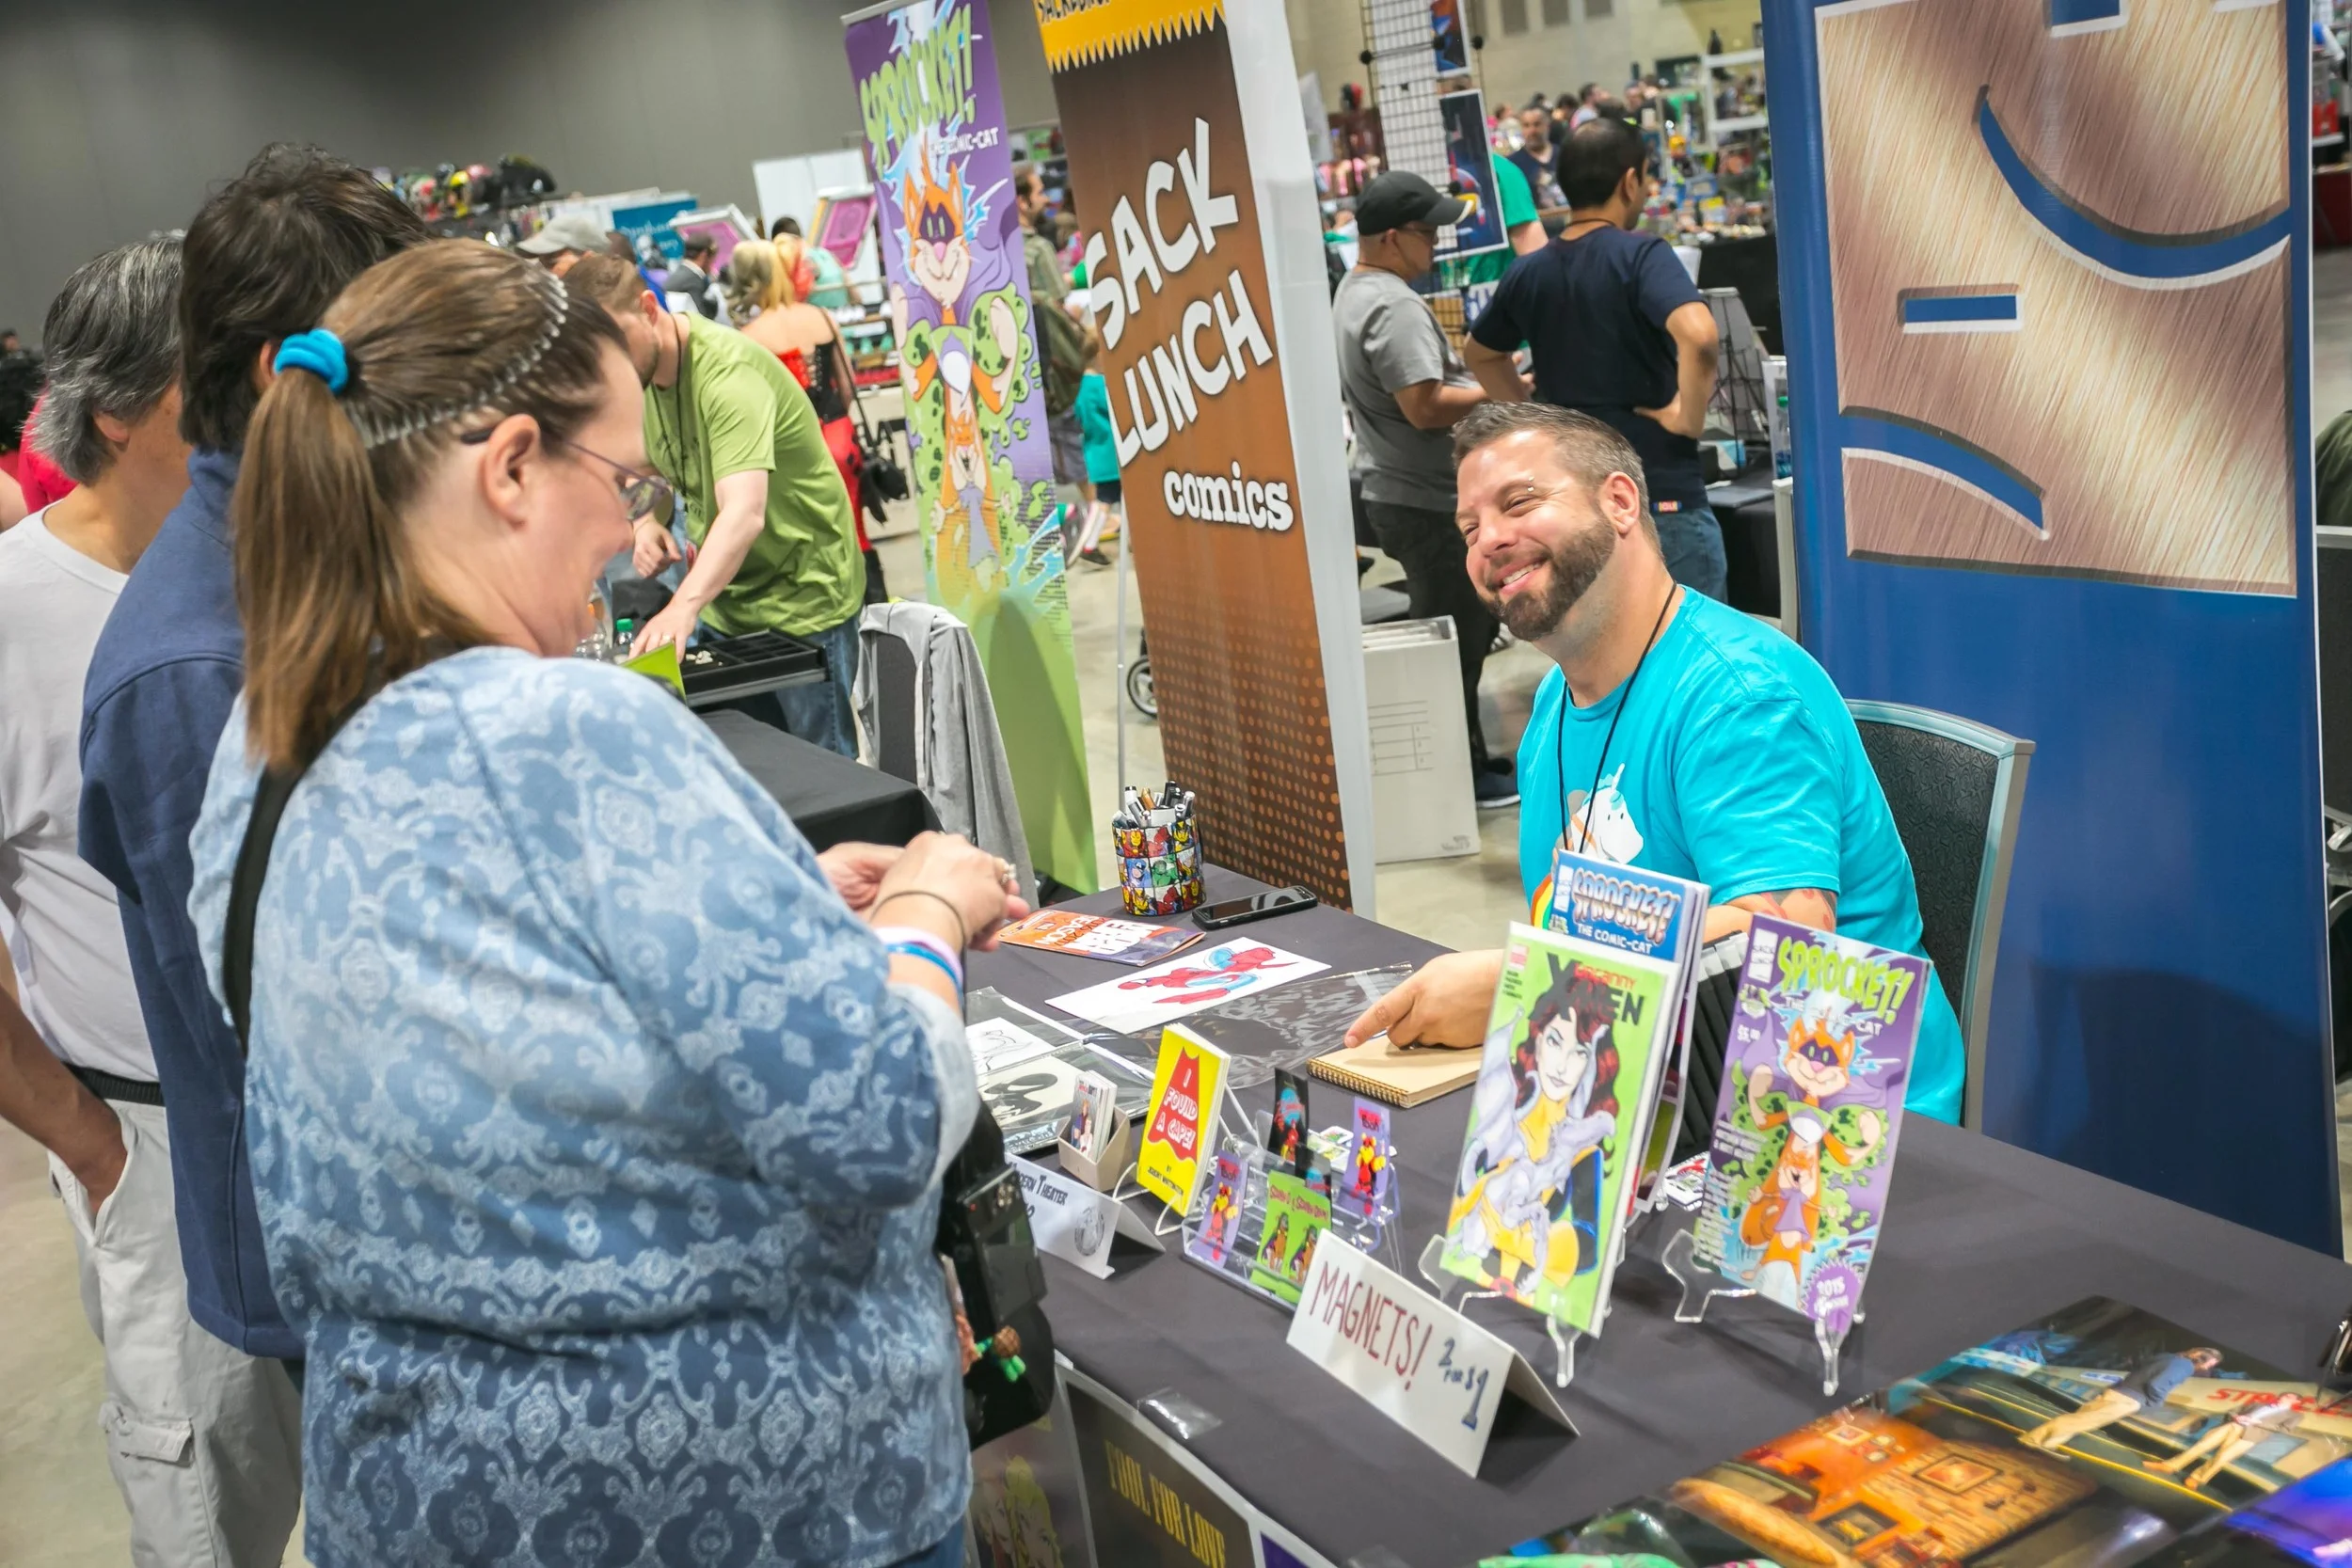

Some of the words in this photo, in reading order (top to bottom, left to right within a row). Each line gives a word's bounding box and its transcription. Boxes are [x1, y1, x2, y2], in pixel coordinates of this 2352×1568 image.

[860, 3, 977, 182] SPROCKET!
[1086, 117, 1240, 352] SACK
[1104, 269, 1274, 468] LUNCH
[1164, 460, 1294, 531] comics
[1571, 867, 1681, 945] SPROCKET!
[1576, 923, 1593, 938] THE
[1594, 928, 1654, 955] COMIC-CAT
[1777, 936, 1915, 1025] SPROCKET!
[1163, 1085, 1200, 1122] FOUND
[1183, 1068, 1192, 1088] I
[1155, 1111, 1166, 1133] A
[1168, 1117, 1198, 1151] CAPE!
[1036, 1174, 1069, 1207] THEATER
[1308, 1260, 1435, 1392] MAGNETS!
[1438, 1337, 1456, 1369] 2
[1104, 1439, 1152, 1517] FOOL
[1149, 1472, 1187, 1547] FOR
[1184, 1501, 1227, 1568] LOVE
